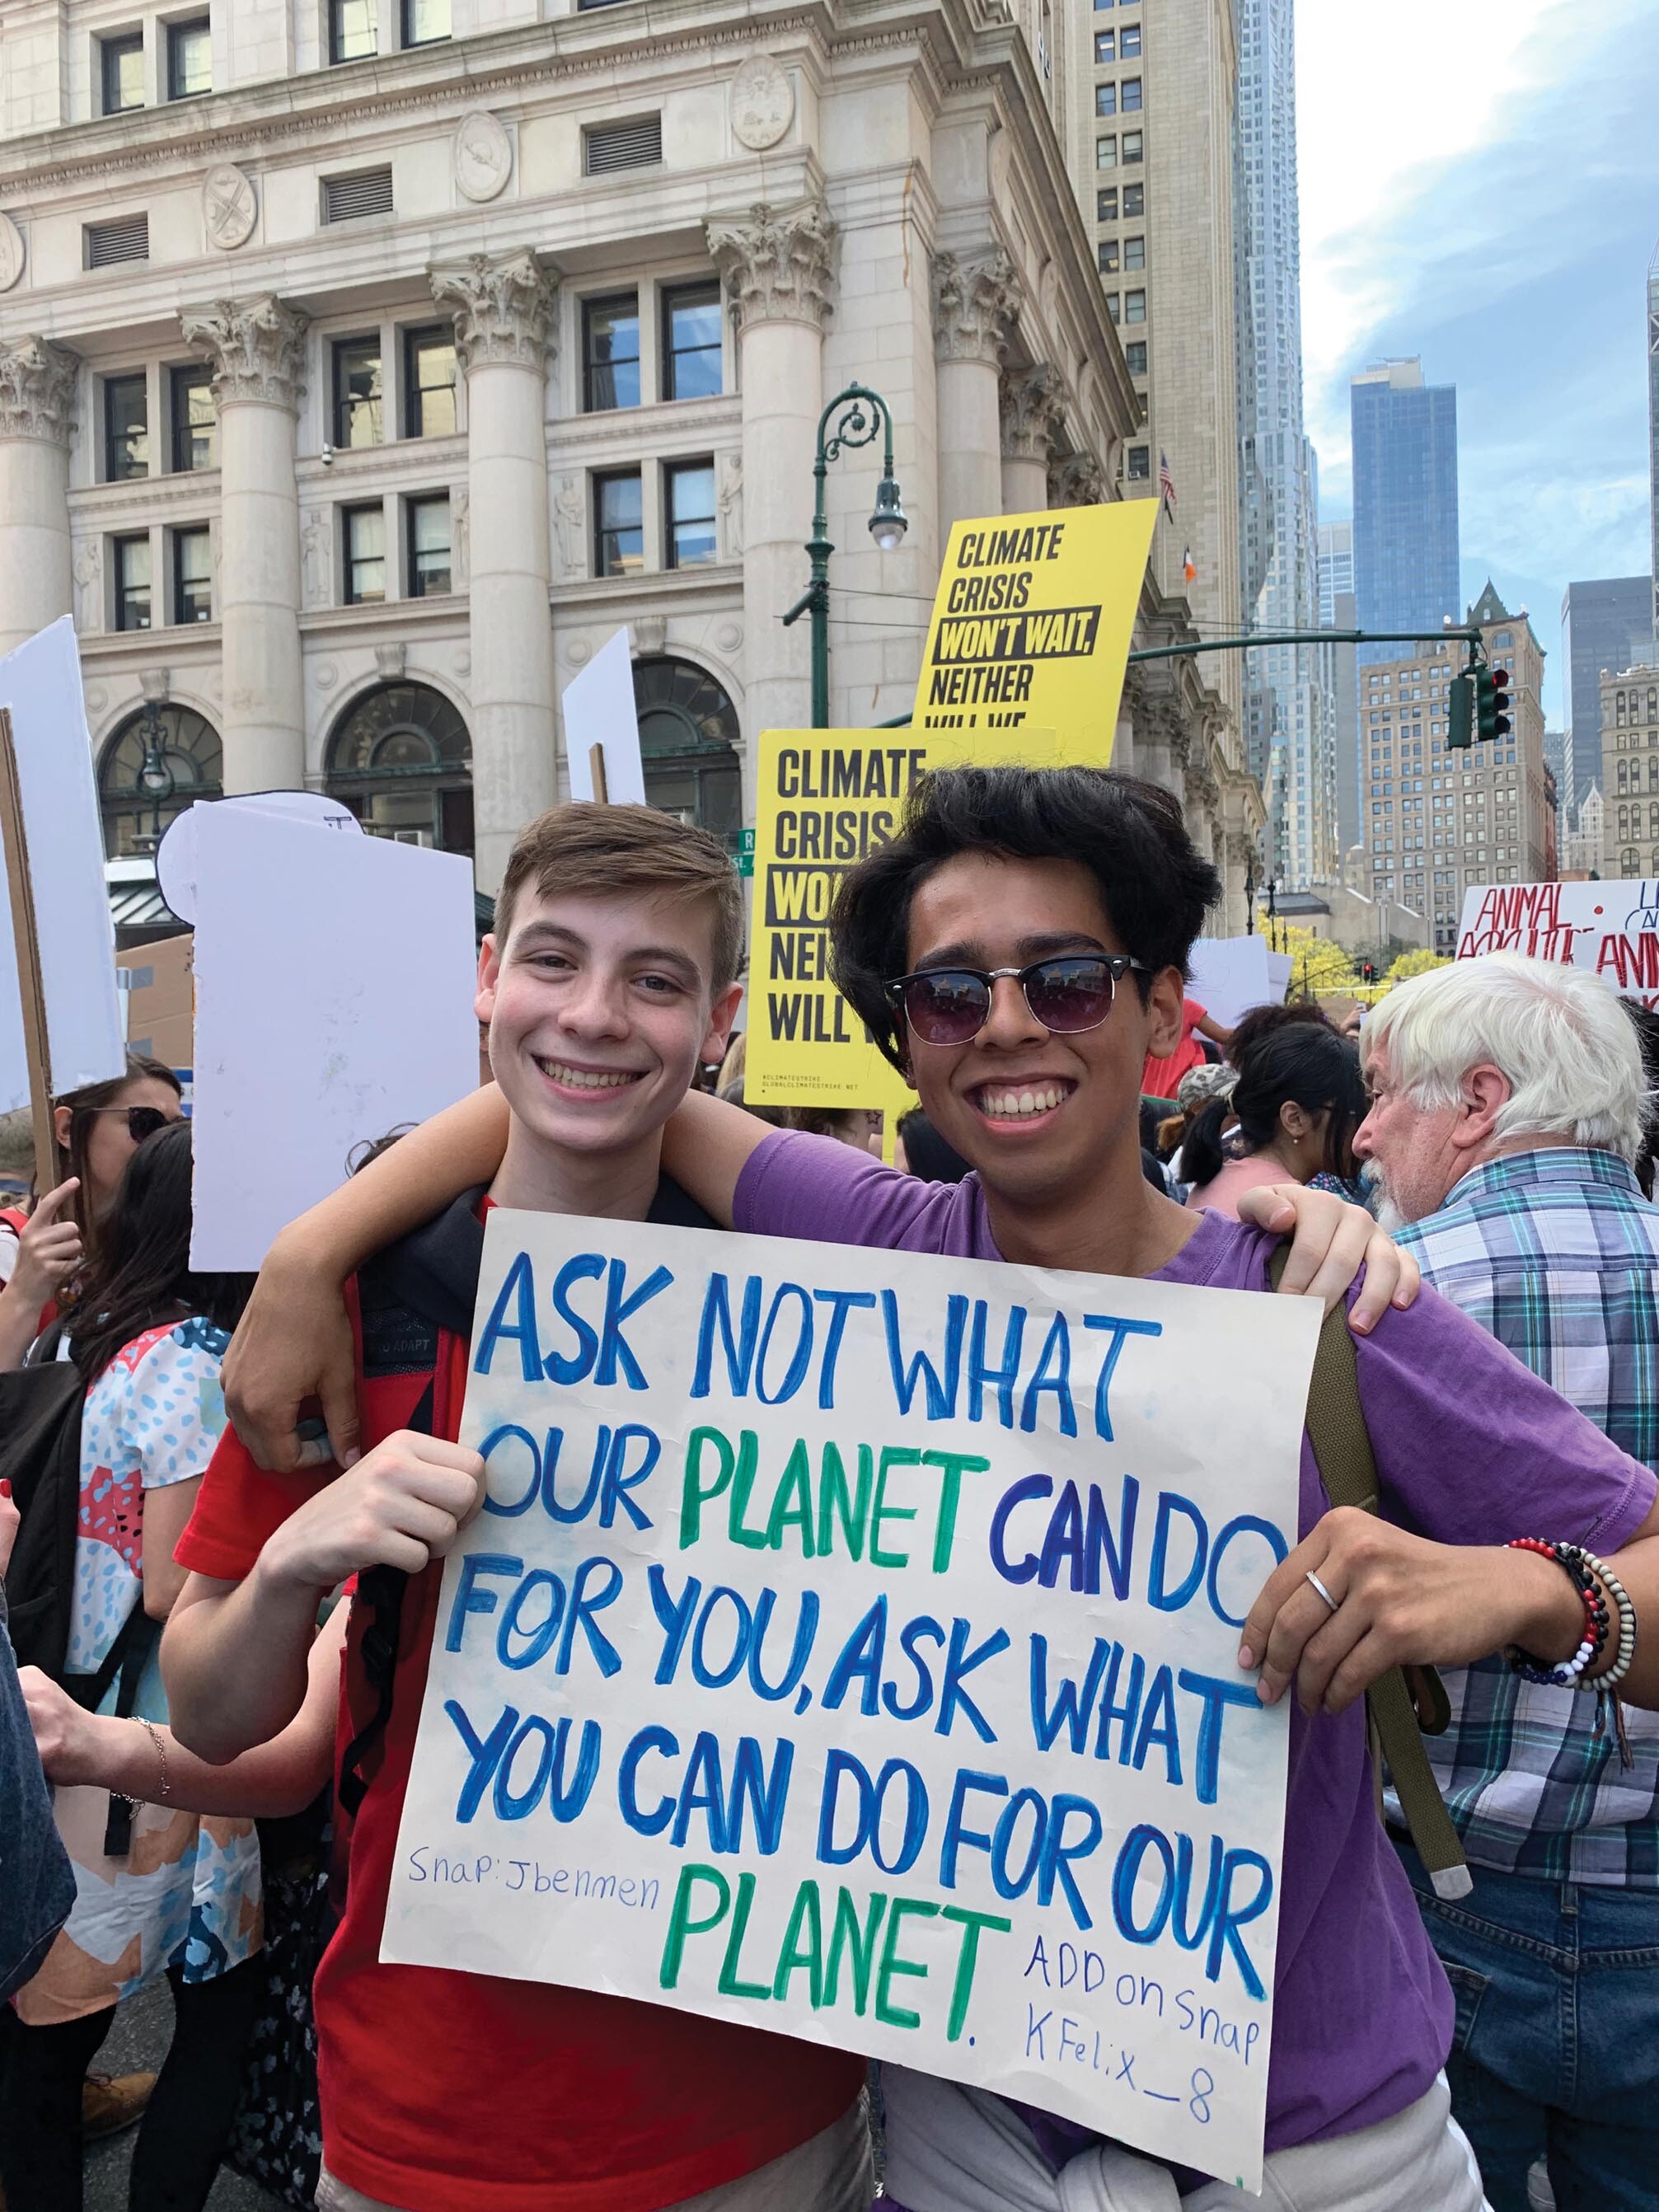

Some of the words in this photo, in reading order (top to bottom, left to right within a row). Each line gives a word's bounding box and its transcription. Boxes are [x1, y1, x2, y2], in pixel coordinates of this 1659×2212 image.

[957, 523, 1065, 569] CLIMATE
[947, 572, 1033, 613] CRISIS
[940, 617, 1022, 660] WON'T
[1024, 610, 1094, 655] WAIT,
[929, 663, 1033, 705] NEITHER
[1475, 883, 1572, 930] ANIMAL
[767, 993, 851, 1043] WILL
[762, 1081, 858, 1090] GLOBALCLIMATESTRIKENET
[474, 1251, 673, 1390] ASK
[690, 1272, 876, 1409] NOT
[880, 1288, 1162, 1441] WHAT
[477, 1423, 661, 1530] OUR
[679, 1426, 991, 1573] PLANET
[990, 1474, 1139, 1600] CAN
[1147, 1492, 1289, 1629] DO
[445, 1553, 624, 1679] FOR
[647, 1564, 820, 1716] YOU,
[821, 1593, 1010, 1744] ASK
[1029, 1633, 1263, 1804] WHAT
[443, 1699, 602, 1824] YOU
[619, 1724, 794, 1855] CAN
[816, 1748, 929, 1875] DO
[940, 1769, 1103, 1931] FOR
[1111, 1823, 1274, 2002] OUR
[659, 1863, 1012, 2046] PLANET.
[1024, 1934, 1105, 1993] ADD
